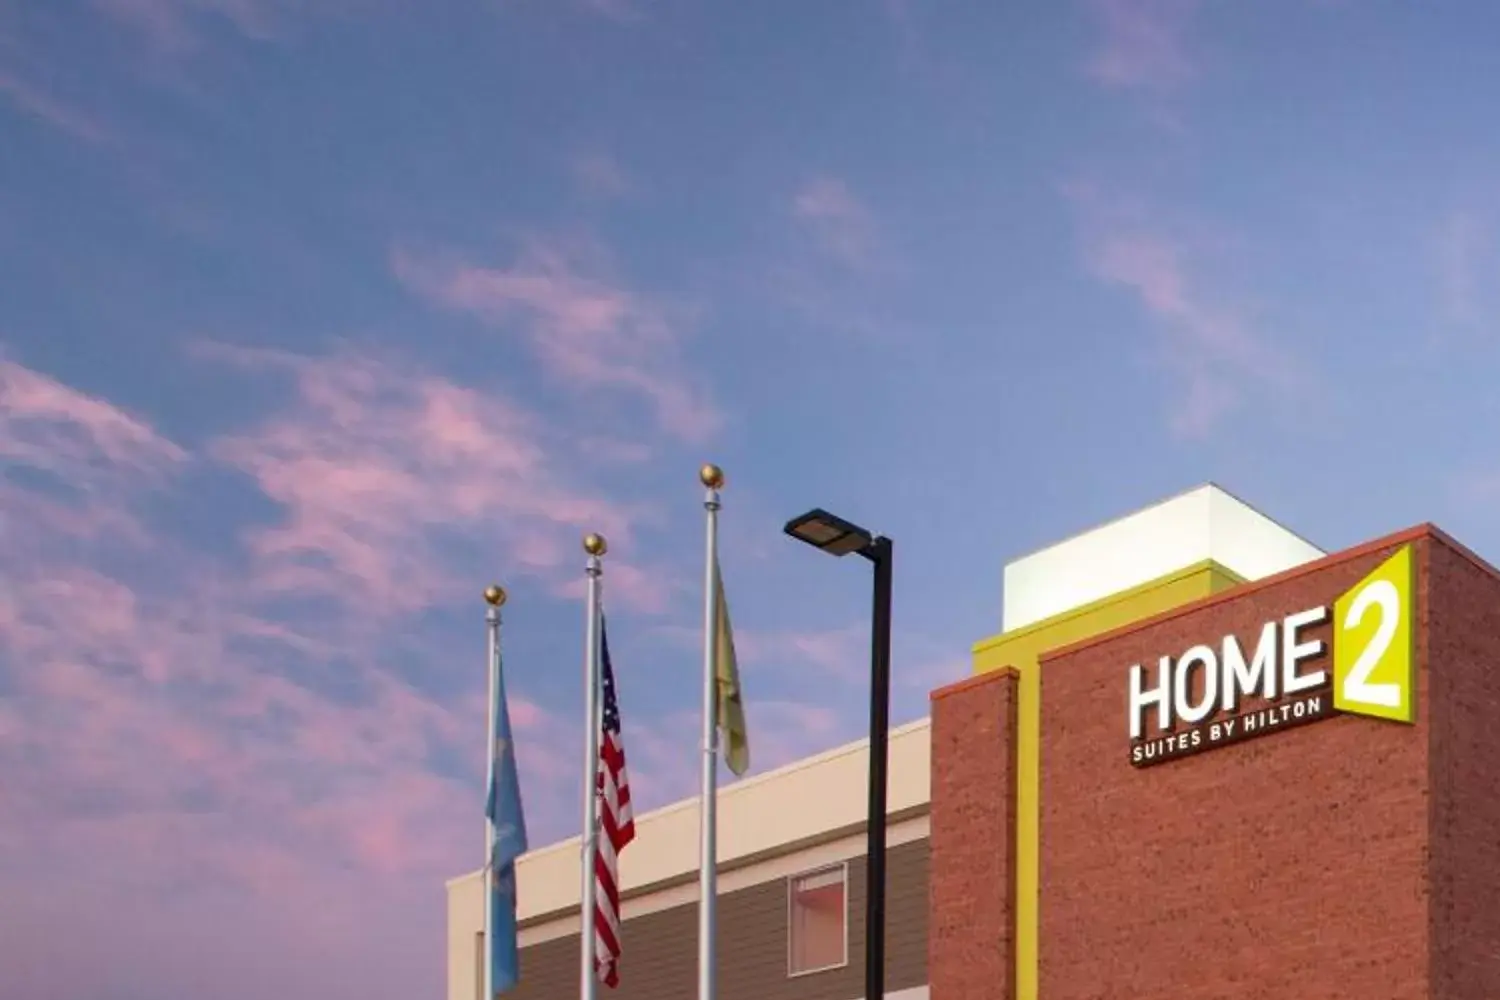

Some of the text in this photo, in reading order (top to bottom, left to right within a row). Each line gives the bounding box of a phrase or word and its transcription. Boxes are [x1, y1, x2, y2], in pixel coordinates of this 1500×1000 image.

[1129, 579, 1400, 738] HOME 2
[1133, 697, 1321, 762] SUITES BY HILTON
